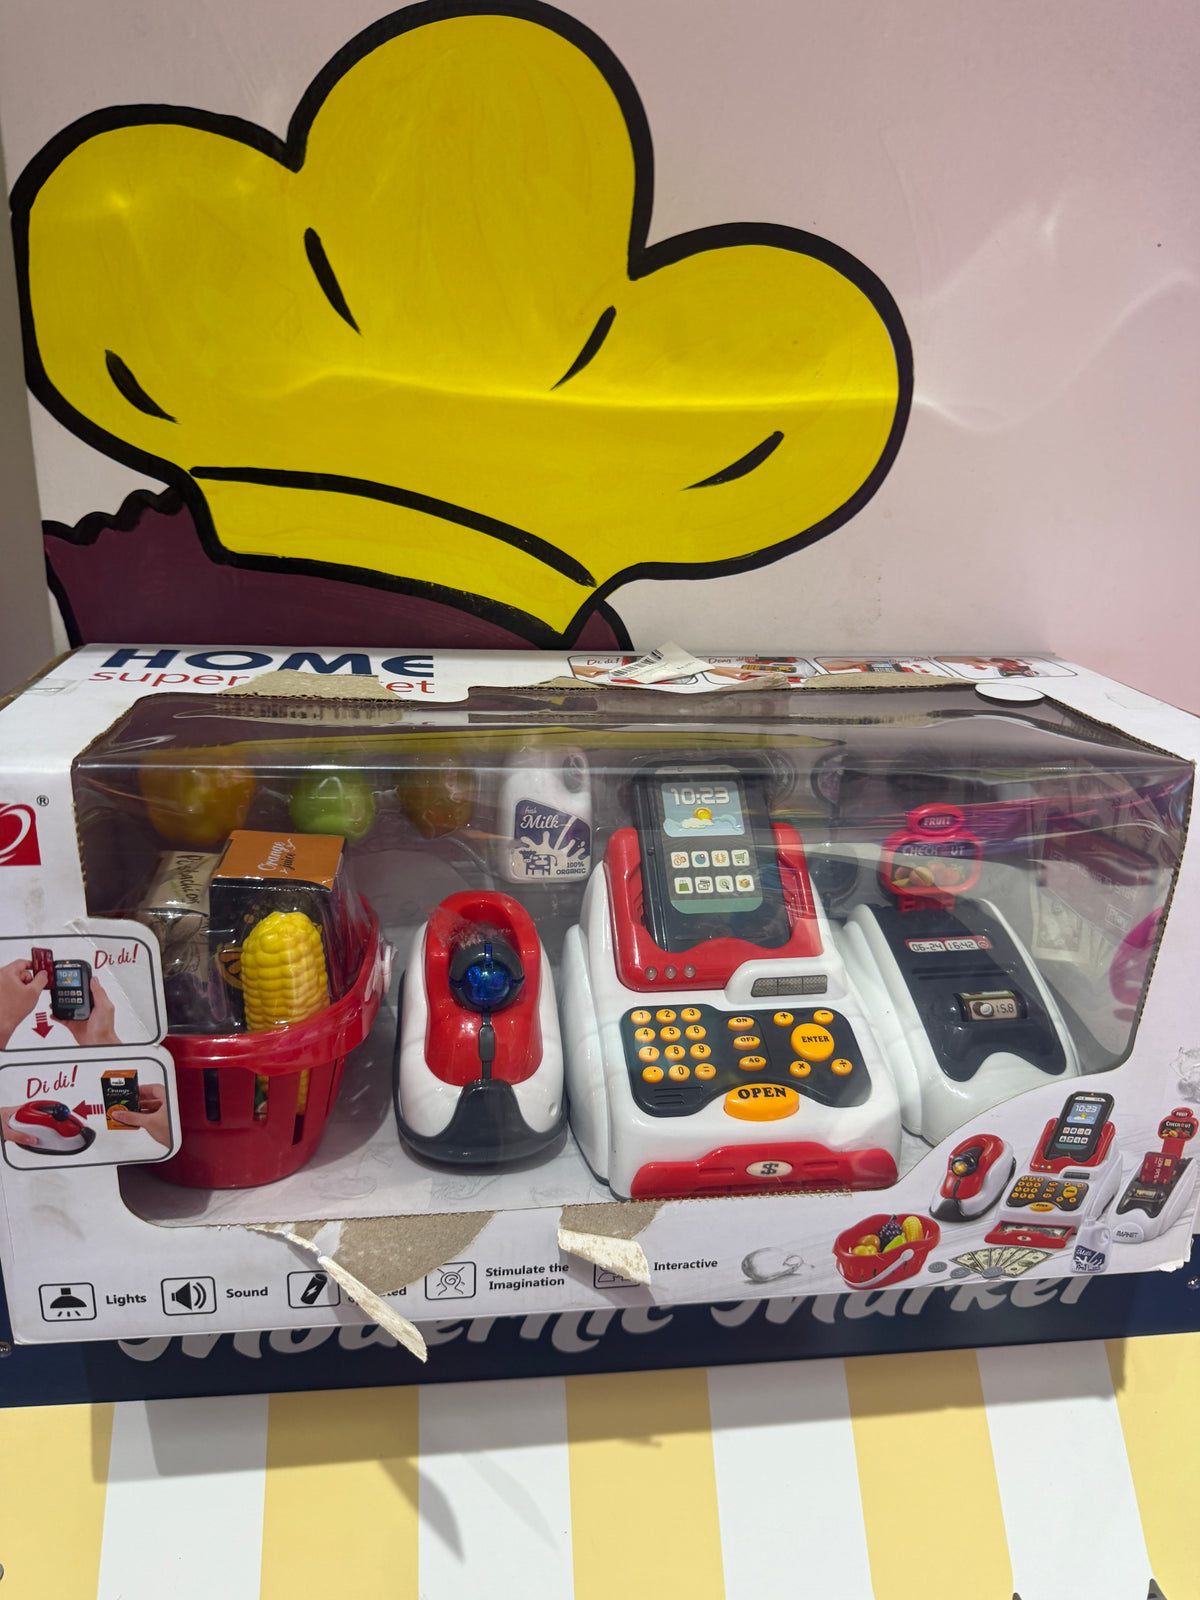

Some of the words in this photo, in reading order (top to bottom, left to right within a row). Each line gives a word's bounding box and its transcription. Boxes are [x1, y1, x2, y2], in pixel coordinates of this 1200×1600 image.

[101, 648, 434, 678] HOME
[670, 786, 730, 806] 10:23
[520, 814, 560, 829] Milk
[923, 816, 952, 827] FRUIT
[556, 868, 587, 876] ORGANIC
[94, 950, 115, 970] Di
[117, 943, 139, 964] di!
[801, 1035, 830, 1043] ENTER
[26, 1078, 50, 1099] Di
[53, 1065, 78, 1091] di!
[737, 1087, 787, 1099] OPEN
[485, 1266, 546, 1278] Stimulate
[548, 1264, 569, 1273] the
[653, 1259, 718, 1271] Interactive
[489, 1277, 565, 1291] Imagination
[226, 1286, 269, 1299] Sound
[105, 1293, 147, 1307] Lights
